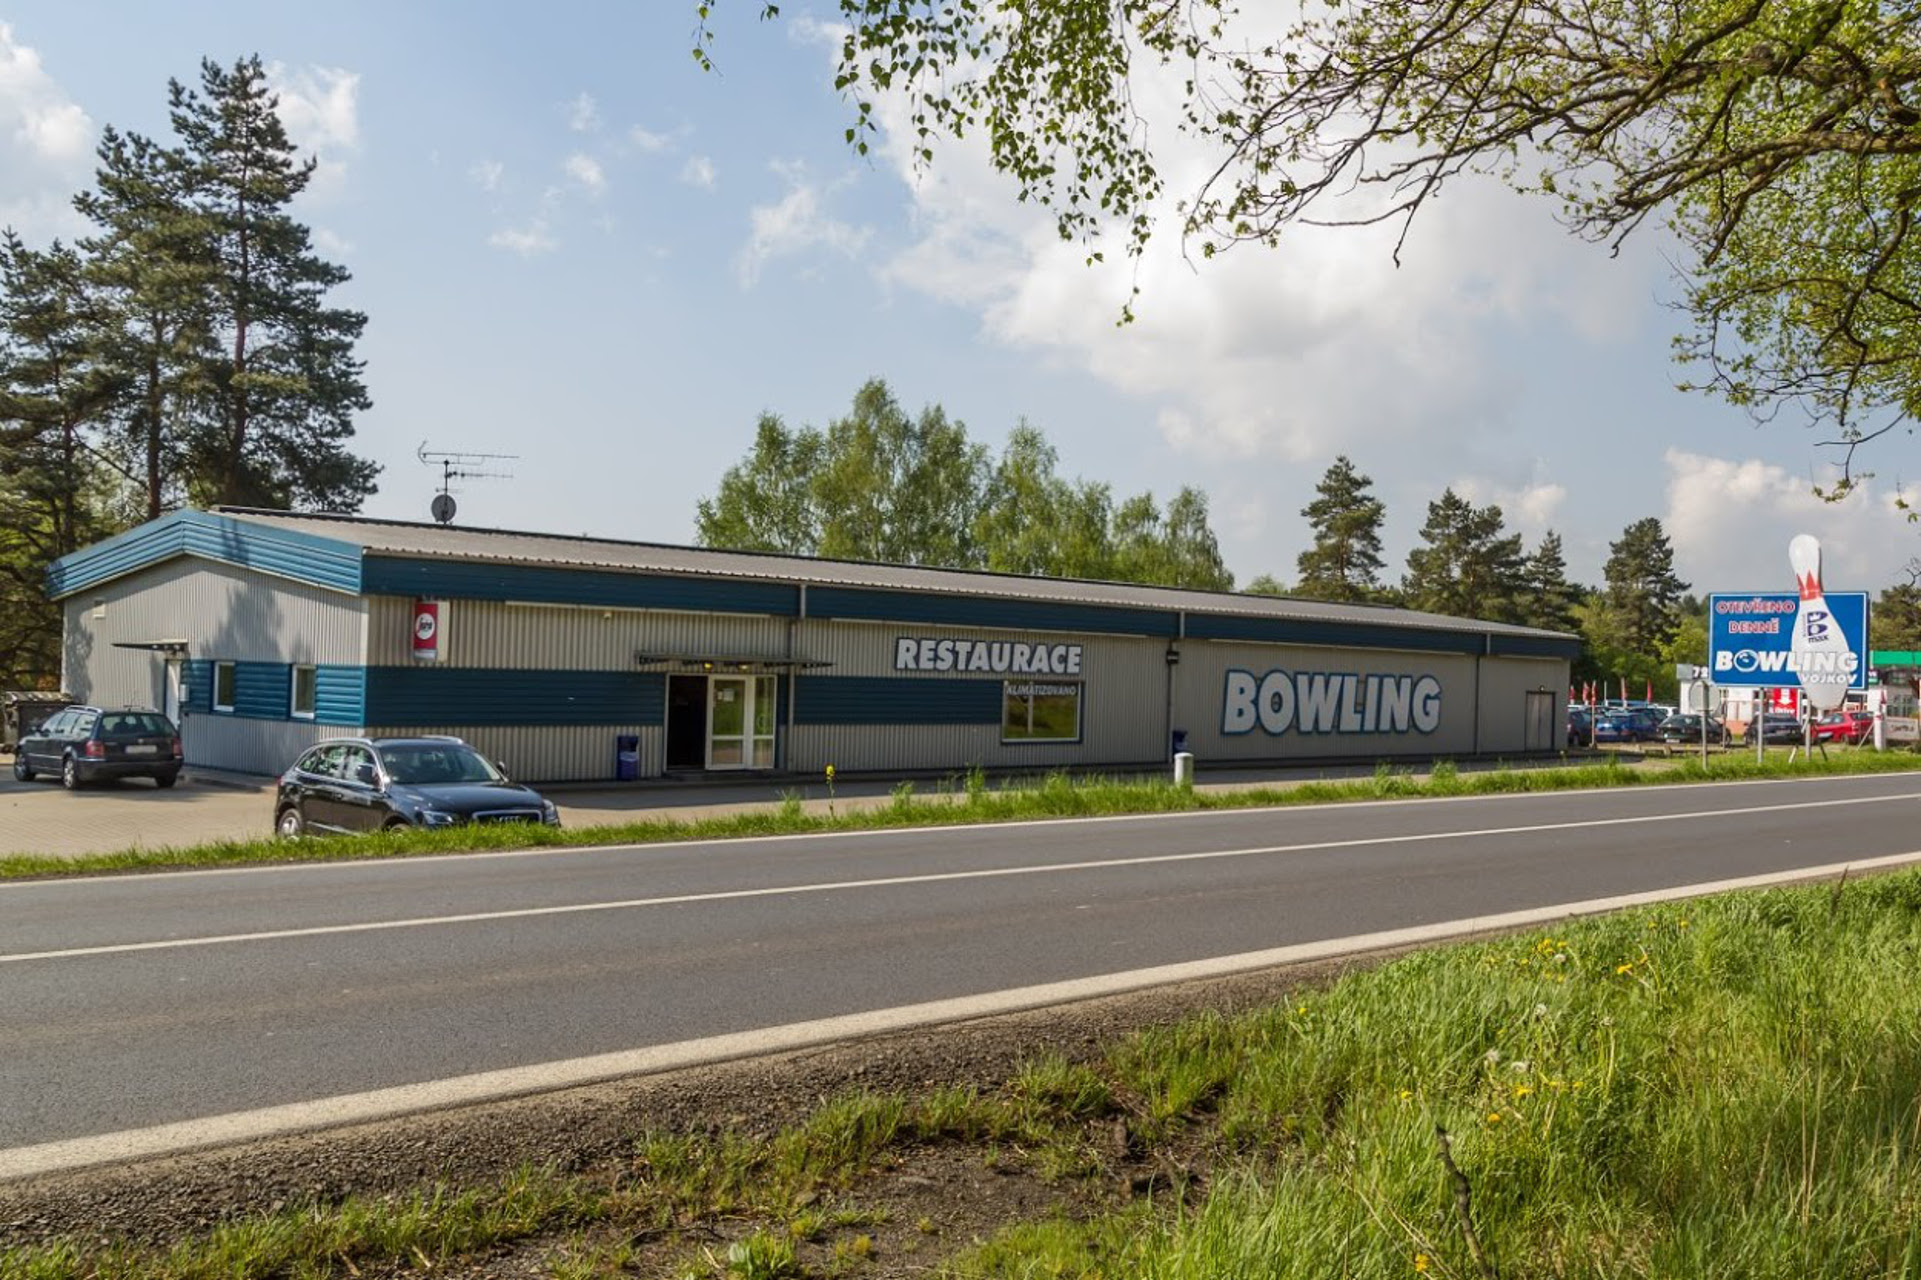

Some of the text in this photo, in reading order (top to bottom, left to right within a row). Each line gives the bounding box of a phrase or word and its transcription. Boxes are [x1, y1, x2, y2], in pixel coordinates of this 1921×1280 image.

[1715, 597, 1796, 614] OTEVŘENO
[1728, 617, 1779, 633] DENNĚ
[896, 637, 1082, 674] RESTAURACE
[1715, 650, 1859, 672] BOWLING
[1800, 673, 1858, 685] VOJKOV
[1221, 669, 1442, 736] BOWLING
